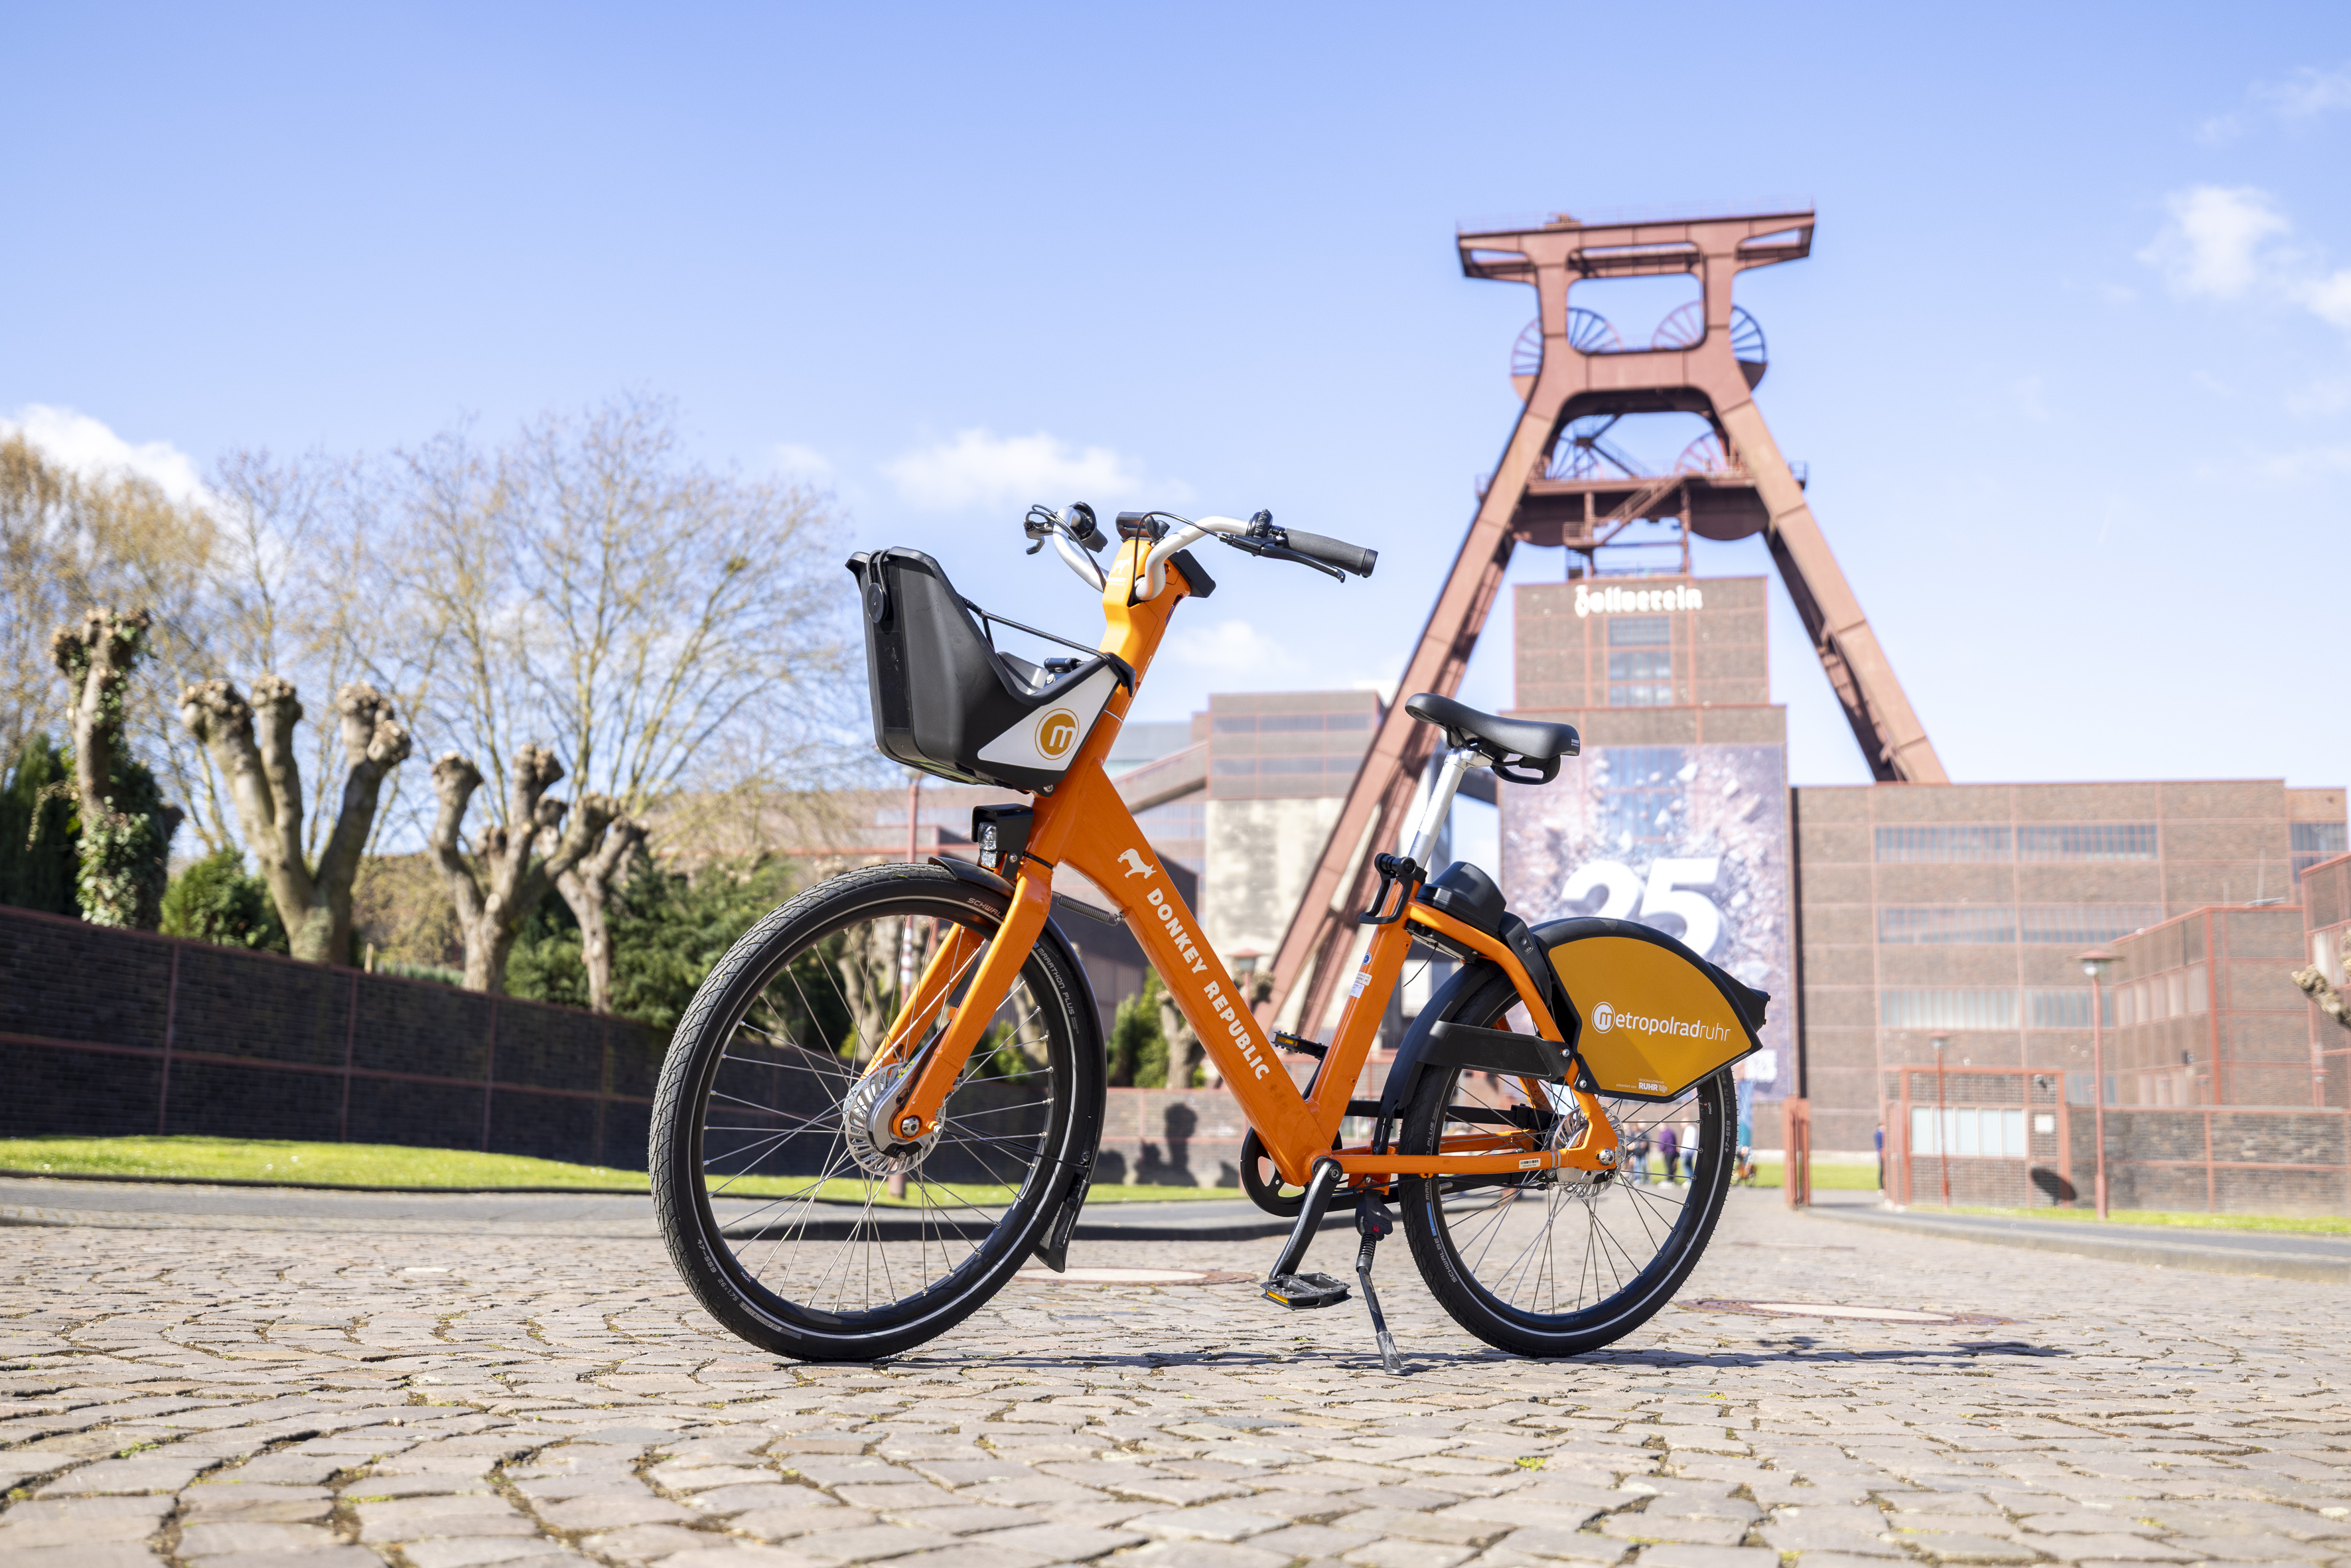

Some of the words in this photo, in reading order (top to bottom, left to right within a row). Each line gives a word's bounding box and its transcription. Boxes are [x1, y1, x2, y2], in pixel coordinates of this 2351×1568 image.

[967, 897, 1006, 920] SCHWALB
[1561, 857, 1720, 958] 25
[1036, 948, 1066, 989] MARATHON
[1062, 991, 1075, 1015] PLUS
[1147, 887, 1208, 974] DONKEY
[1203, 980, 1270, 1081] REPUBLIC
[1591, 1001, 1731, 1041] metropolradruhr
[1638, 1082, 1658, 1092] RUHR
[697, 1239, 717, 1273] 47-559
[1434, 1238, 1458, 1283] SCHWALBE
